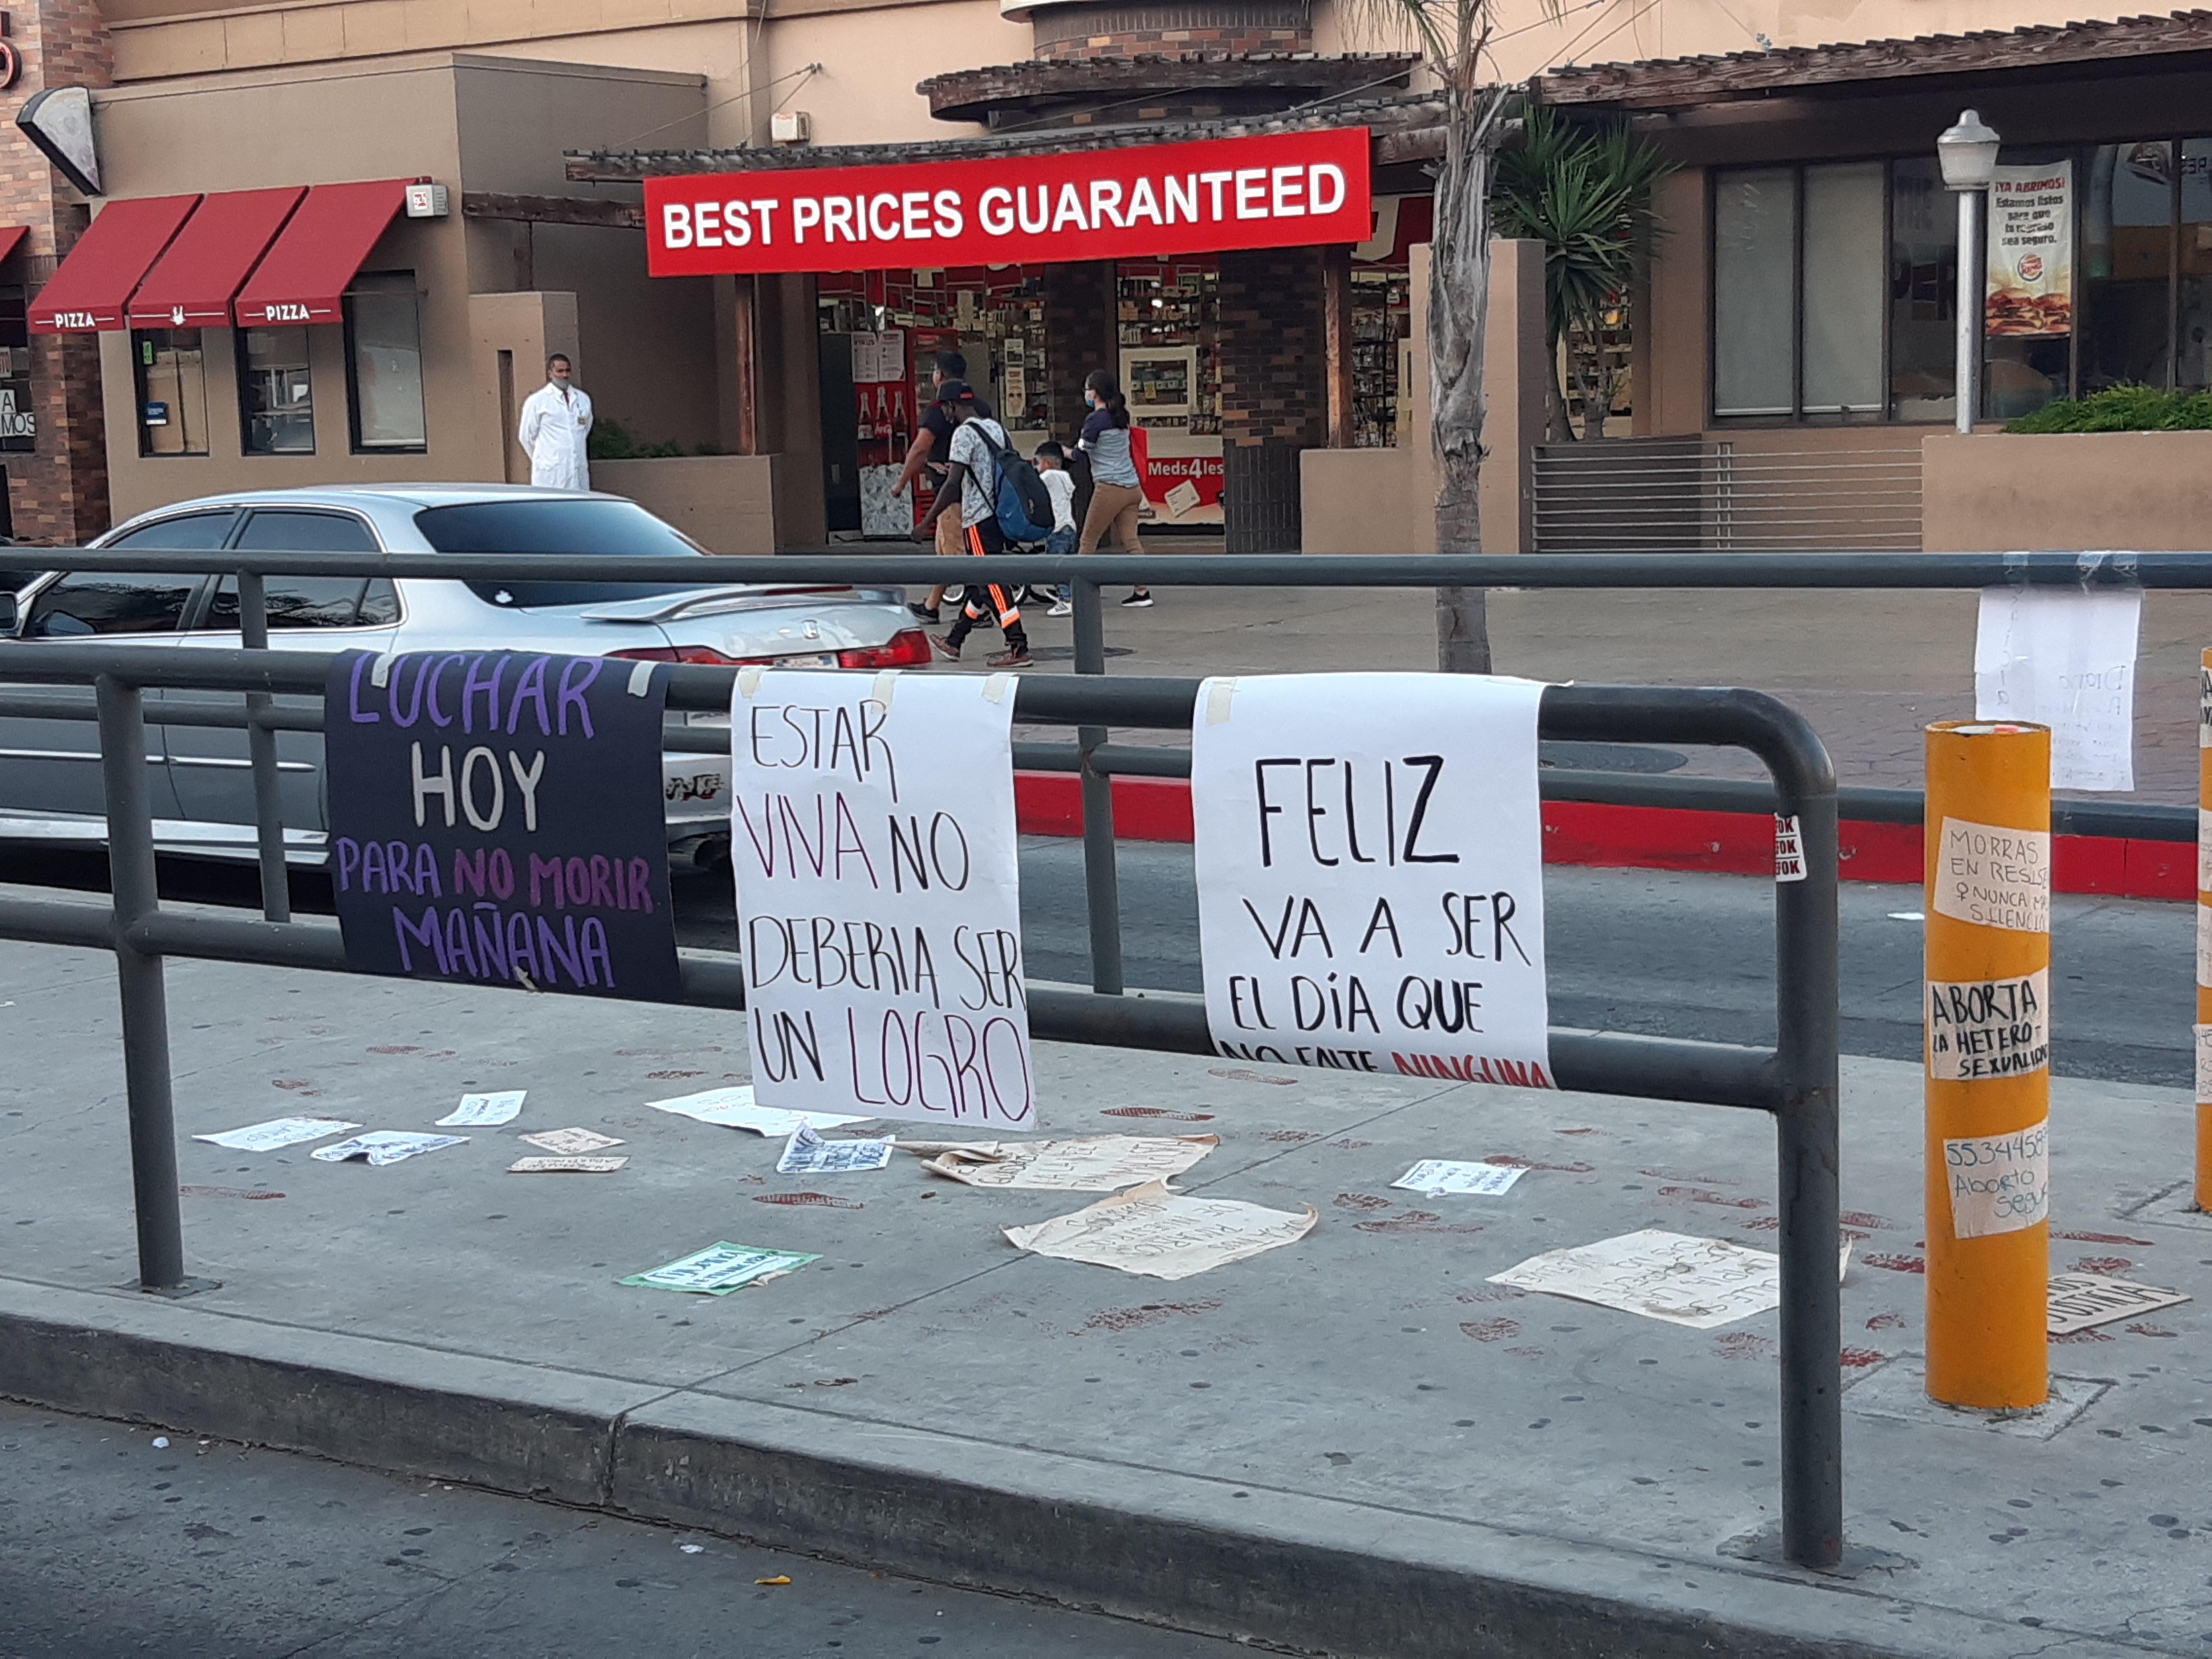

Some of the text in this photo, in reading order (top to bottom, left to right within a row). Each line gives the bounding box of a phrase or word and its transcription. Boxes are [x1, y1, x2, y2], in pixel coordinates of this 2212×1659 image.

[663, 163, 1346, 249] BEST PRICES GUARANTEED
[55, 312, 96, 328] PIZZA
[266, 303, 311, 321] PIZZA
[349, 651, 604, 739] LUCHAR
[411, 741, 546, 831] HOY
[749, 699, 899, 804] ESTAR
[735, 791, 970, 894] VIVA NO
[1255, 755, 1460, 868] FELIZ
[1951, 830, 2038, 865] MORRAS
[336, 836, 654, 914] PARA NO MORIR
[1951, 857, 1978, 876] EN
[1973, 886, 2027, 907] NUNCA
[392, 902, 616, 988] MAÑANA
[749, 914, 1028, 1012] DEBERIA SER
[1242, 890, 1533, 968] VA A SER
[1228, 975, 1277, 1031] EL
[1396, 974, 1485, 1035] QUE
[1932, 980, 2037, 1028] ABORTA
[755, 1006, 1031, 1122] UN LOGRO
[1932, 1034, 1948, 1053] LA
